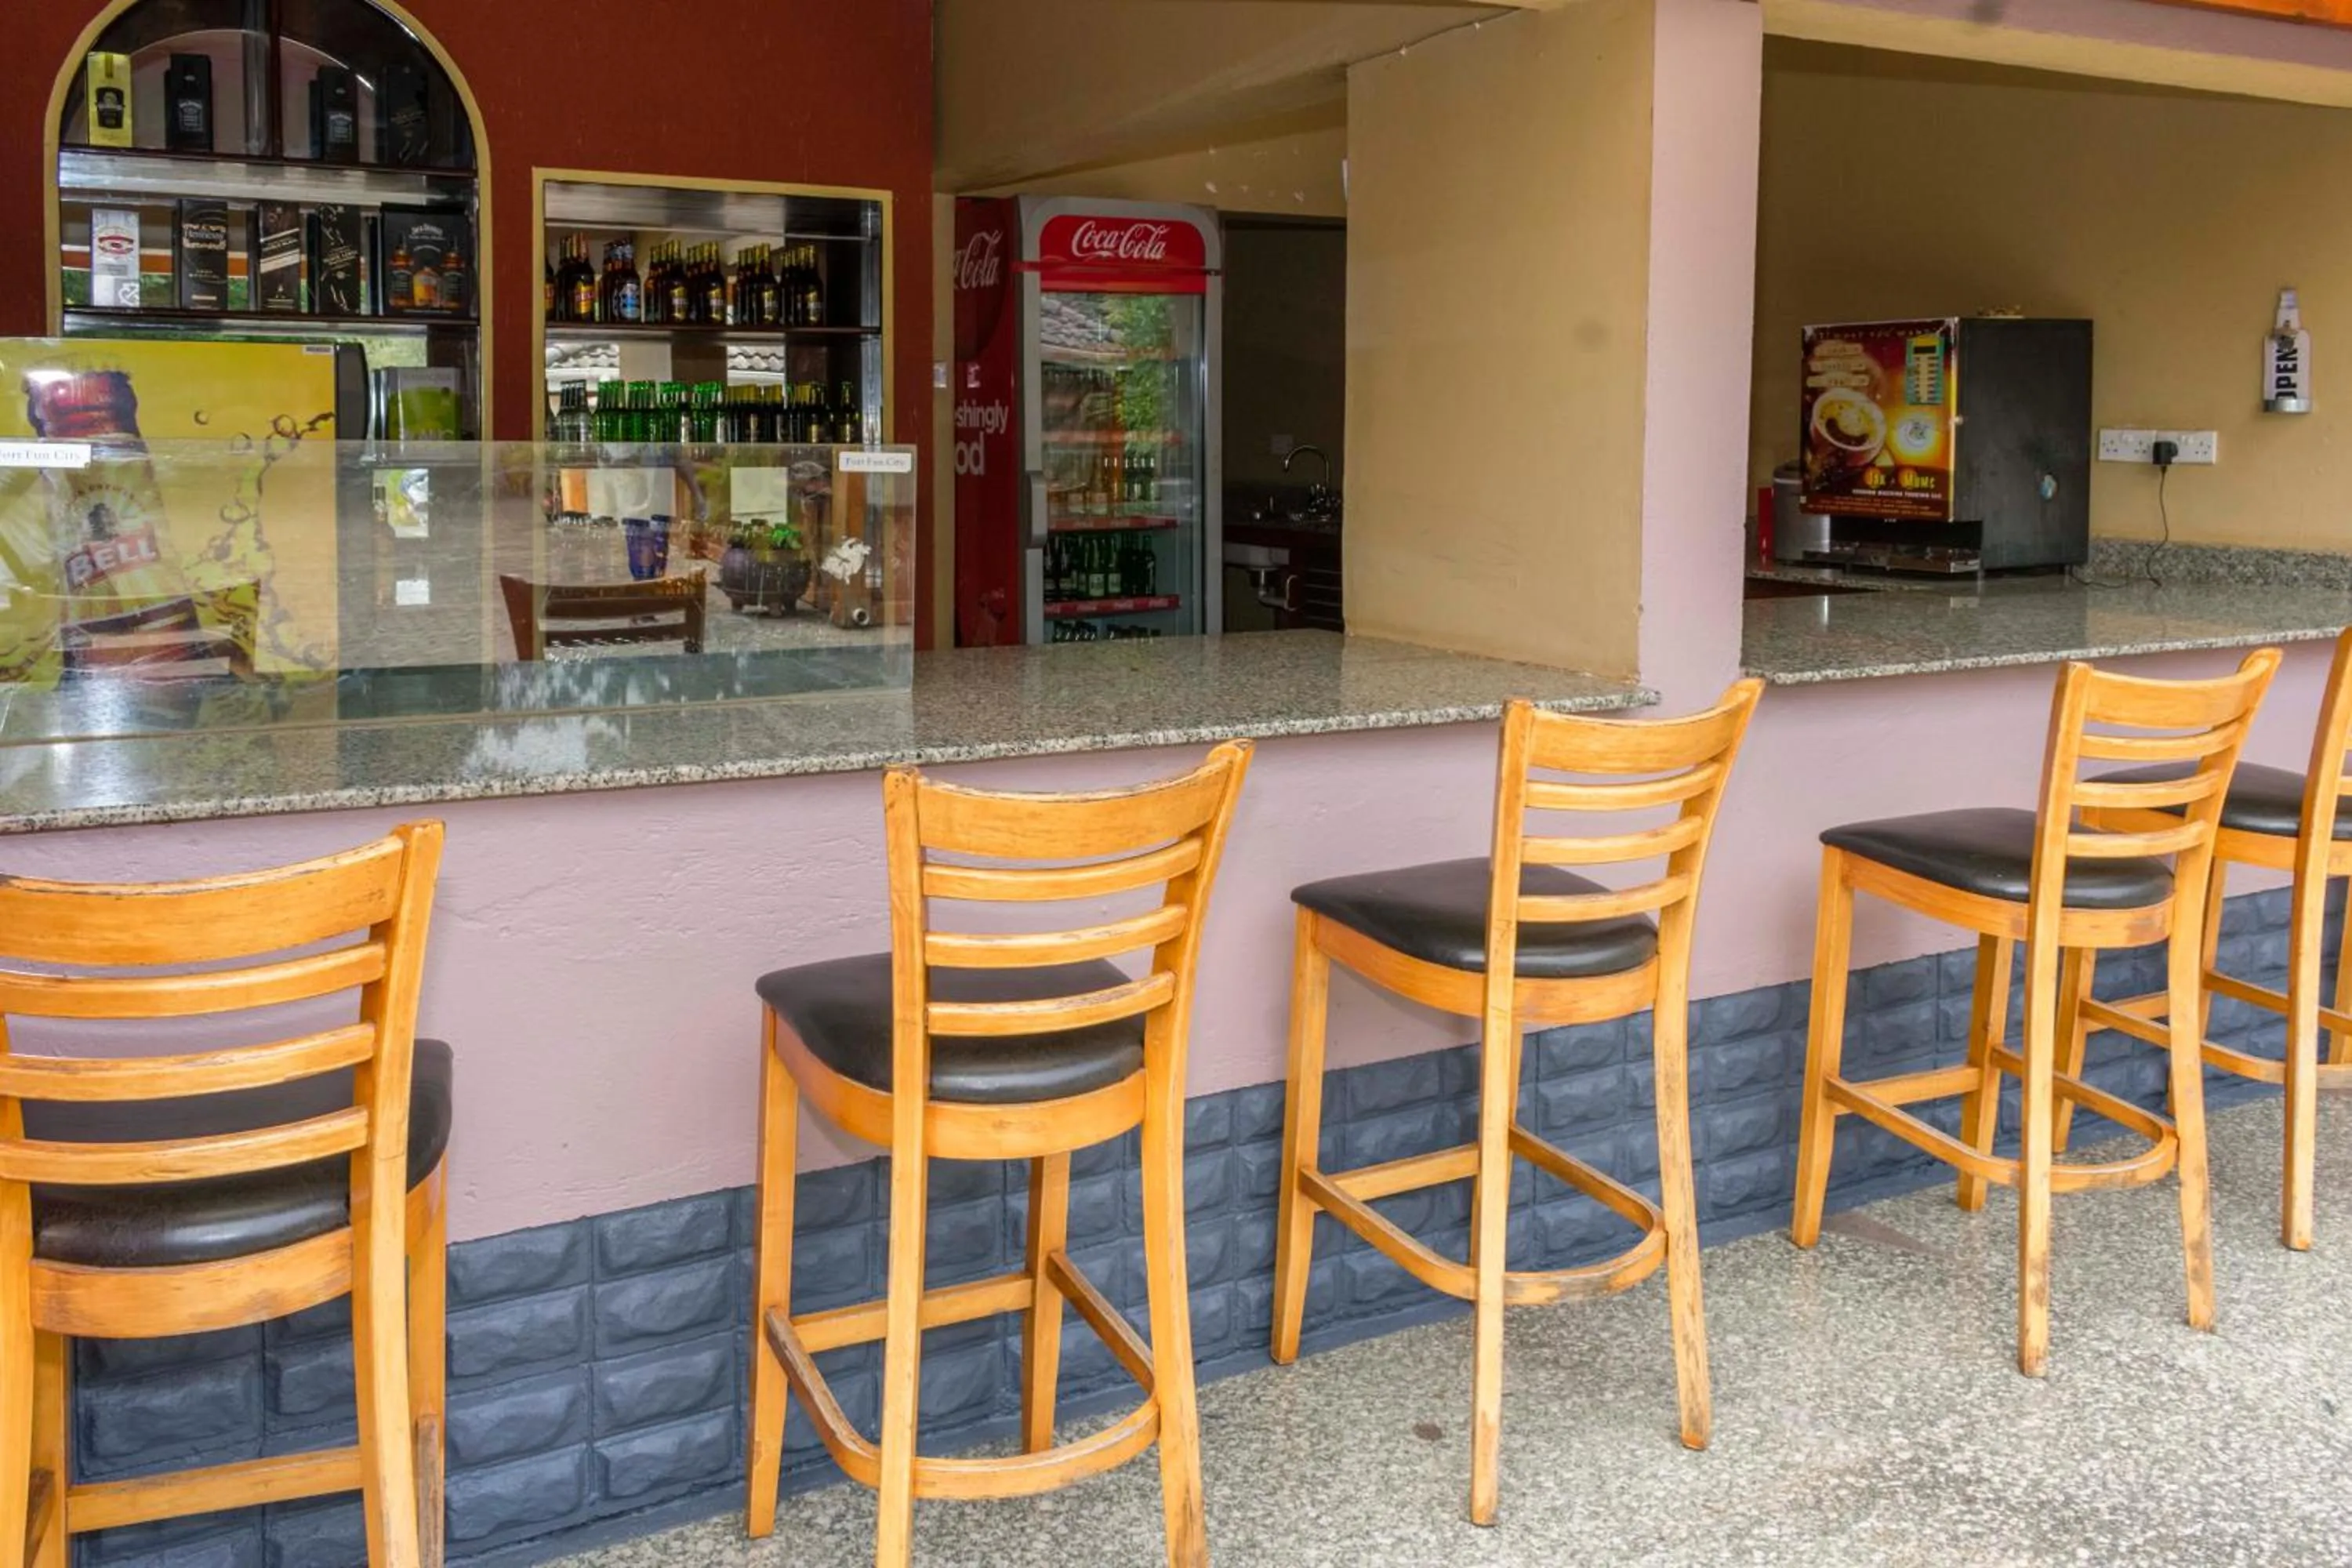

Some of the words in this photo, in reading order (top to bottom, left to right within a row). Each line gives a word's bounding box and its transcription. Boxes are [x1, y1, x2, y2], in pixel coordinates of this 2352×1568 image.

[1072, 220, 1170, 260] Coca-Cola
[956, 399, 1008, 434] shingly
[0, 449, 22, 460] ort
[70, 539, 157, 586] BELL
